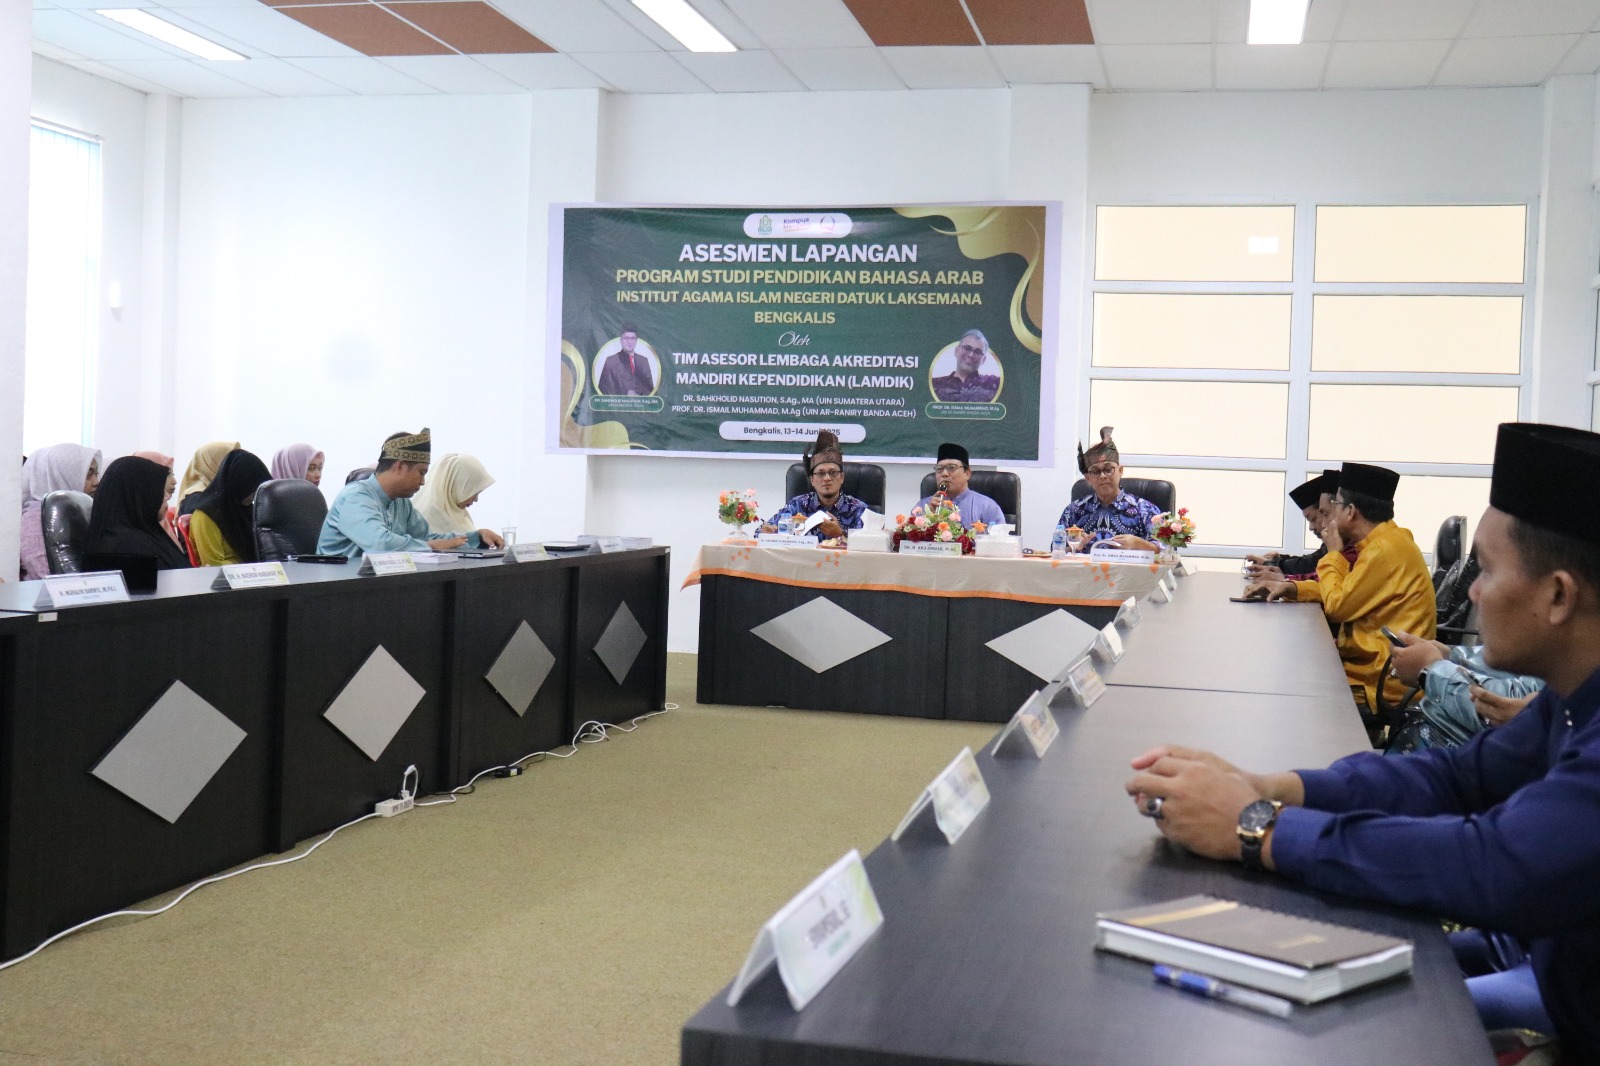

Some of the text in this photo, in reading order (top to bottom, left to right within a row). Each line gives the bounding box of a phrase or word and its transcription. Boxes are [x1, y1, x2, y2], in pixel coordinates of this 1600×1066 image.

[678, 244, 917, 263] ASESMEN LAPANGAN
[616, 269, 984, 285] PROGRAM STUDI PENDIDIKAN BAHASA ARAB
[616, 290, 983, 305] INSTITUT AGAMA ISLAM NEGERI DATUK LAKSEMANA
[754, 311, 836, 324] BENGKALIS
[778, 331, 812, 347] Oleh
[672, 352, 919, 368] TIM ASESOR LEMBAGA AKREDITASI
[676, 372, 914, 390] MANDIRI KEPENDIDIKAN (LAMDIK)
[683, 394, 695, 402] DR.
[696, 395, 738, 403] SAHKHOLID
[738, 396, 779, 404] NASUTION,
[816, 396, 832, 405] (UIN
[833, 397, 875, 405] SUMATERA
[875, 398, 905, 407] UTARA)
[671, 405, 693, 413] PROF.
[706, 406, 730, 414] ISMAIL
[731, 407, 780, 416] MUHAMMAD,
[781, 408, 801, 417] M.Ag
[802, 406, 819, 416] (UIN
[819, 408, 862, 416] AR-RANIRY
[863, 409, 891, 417] BANDA
[891, 408, 917, 418] ACEH)
[743, 426, 783, 436] Bengkalis,
[783, 427, 803, 435] 13-14
